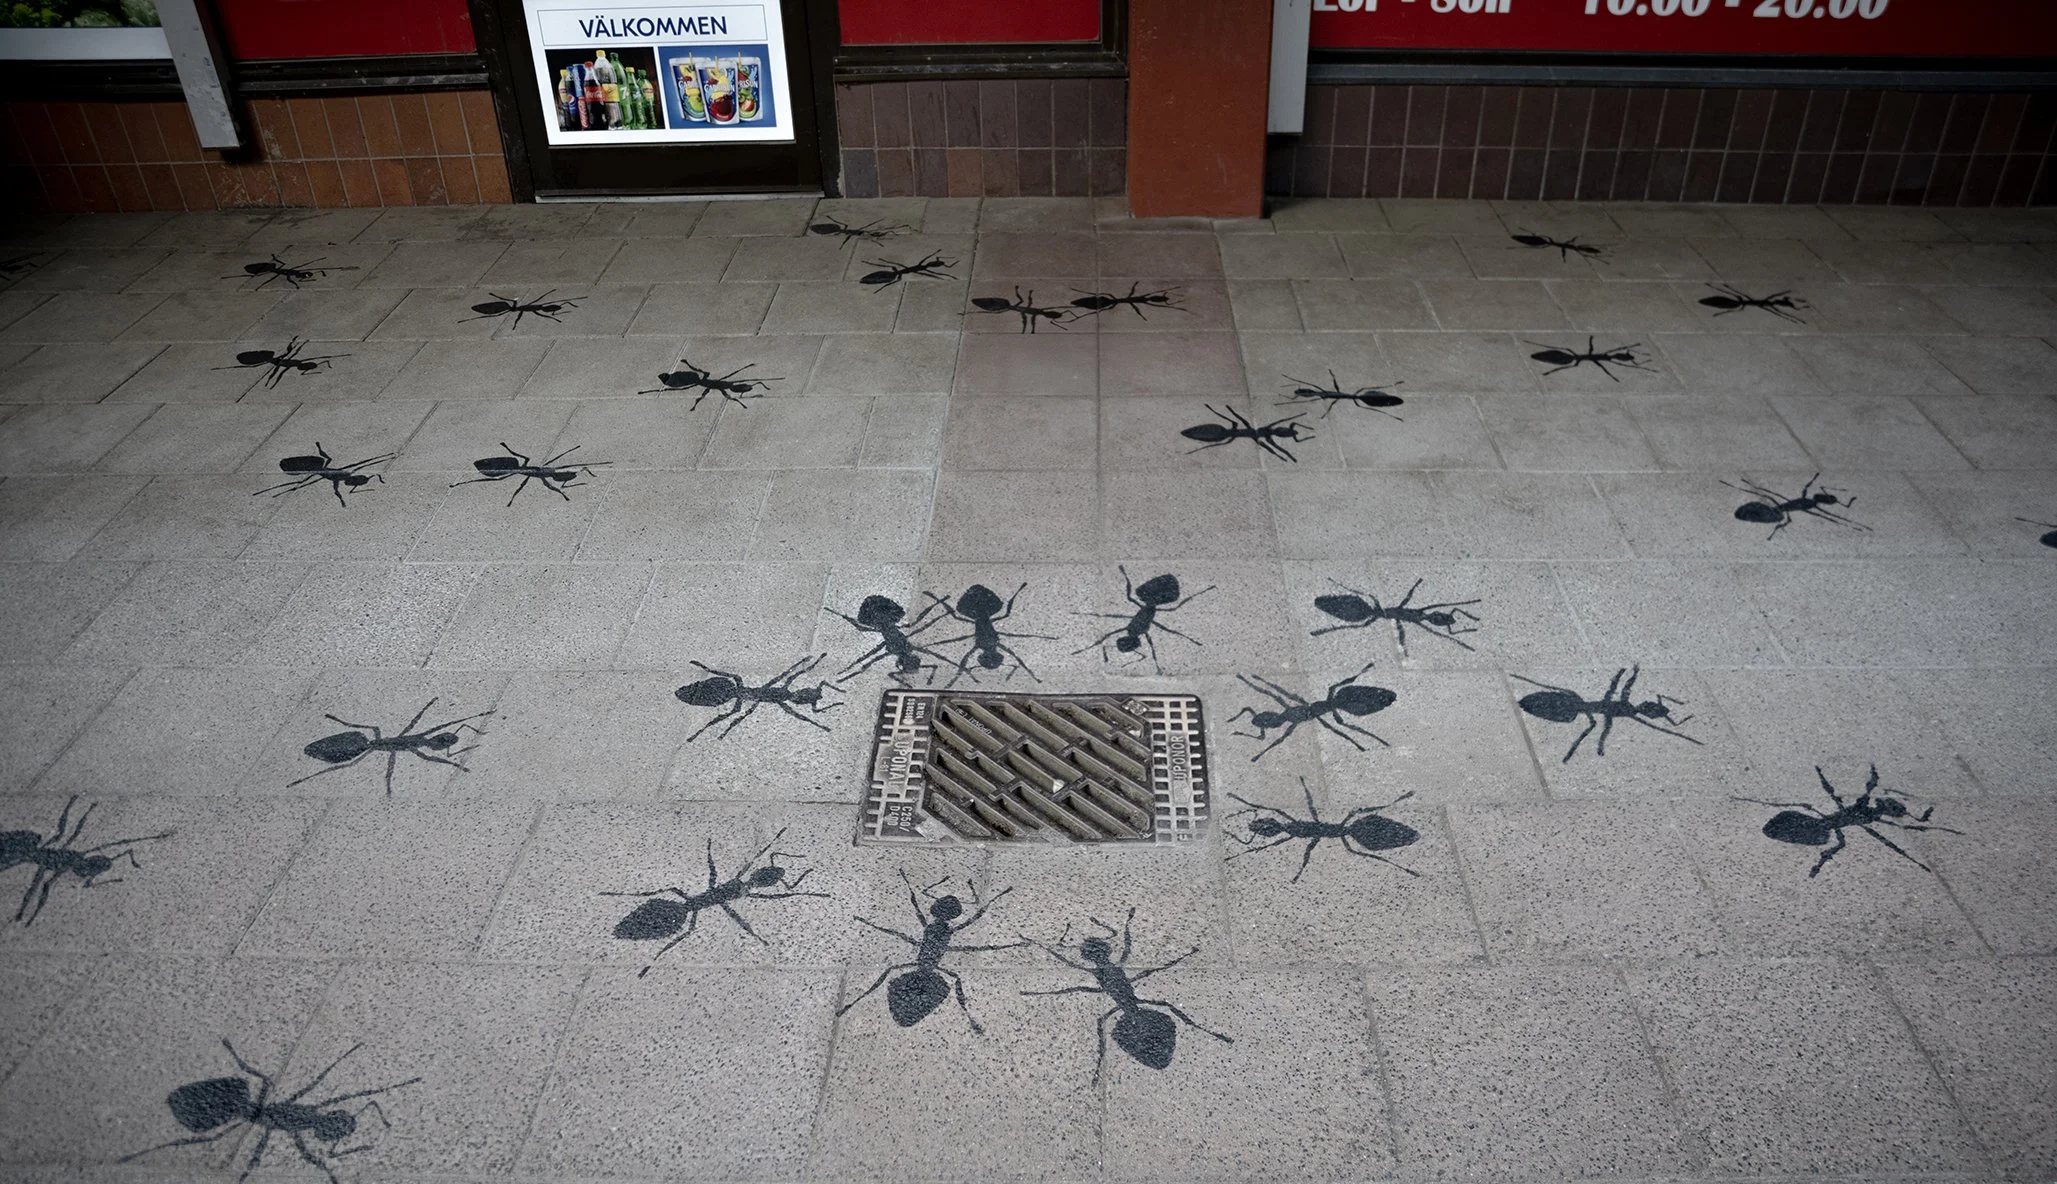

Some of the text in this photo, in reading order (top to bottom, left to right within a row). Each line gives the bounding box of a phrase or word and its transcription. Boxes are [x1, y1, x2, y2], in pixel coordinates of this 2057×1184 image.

[578, 15, 728, 38] VÄLKOMMEN
[888, 741, 910, 787] UPONAL
[899, 806, 913, 832] C250/
